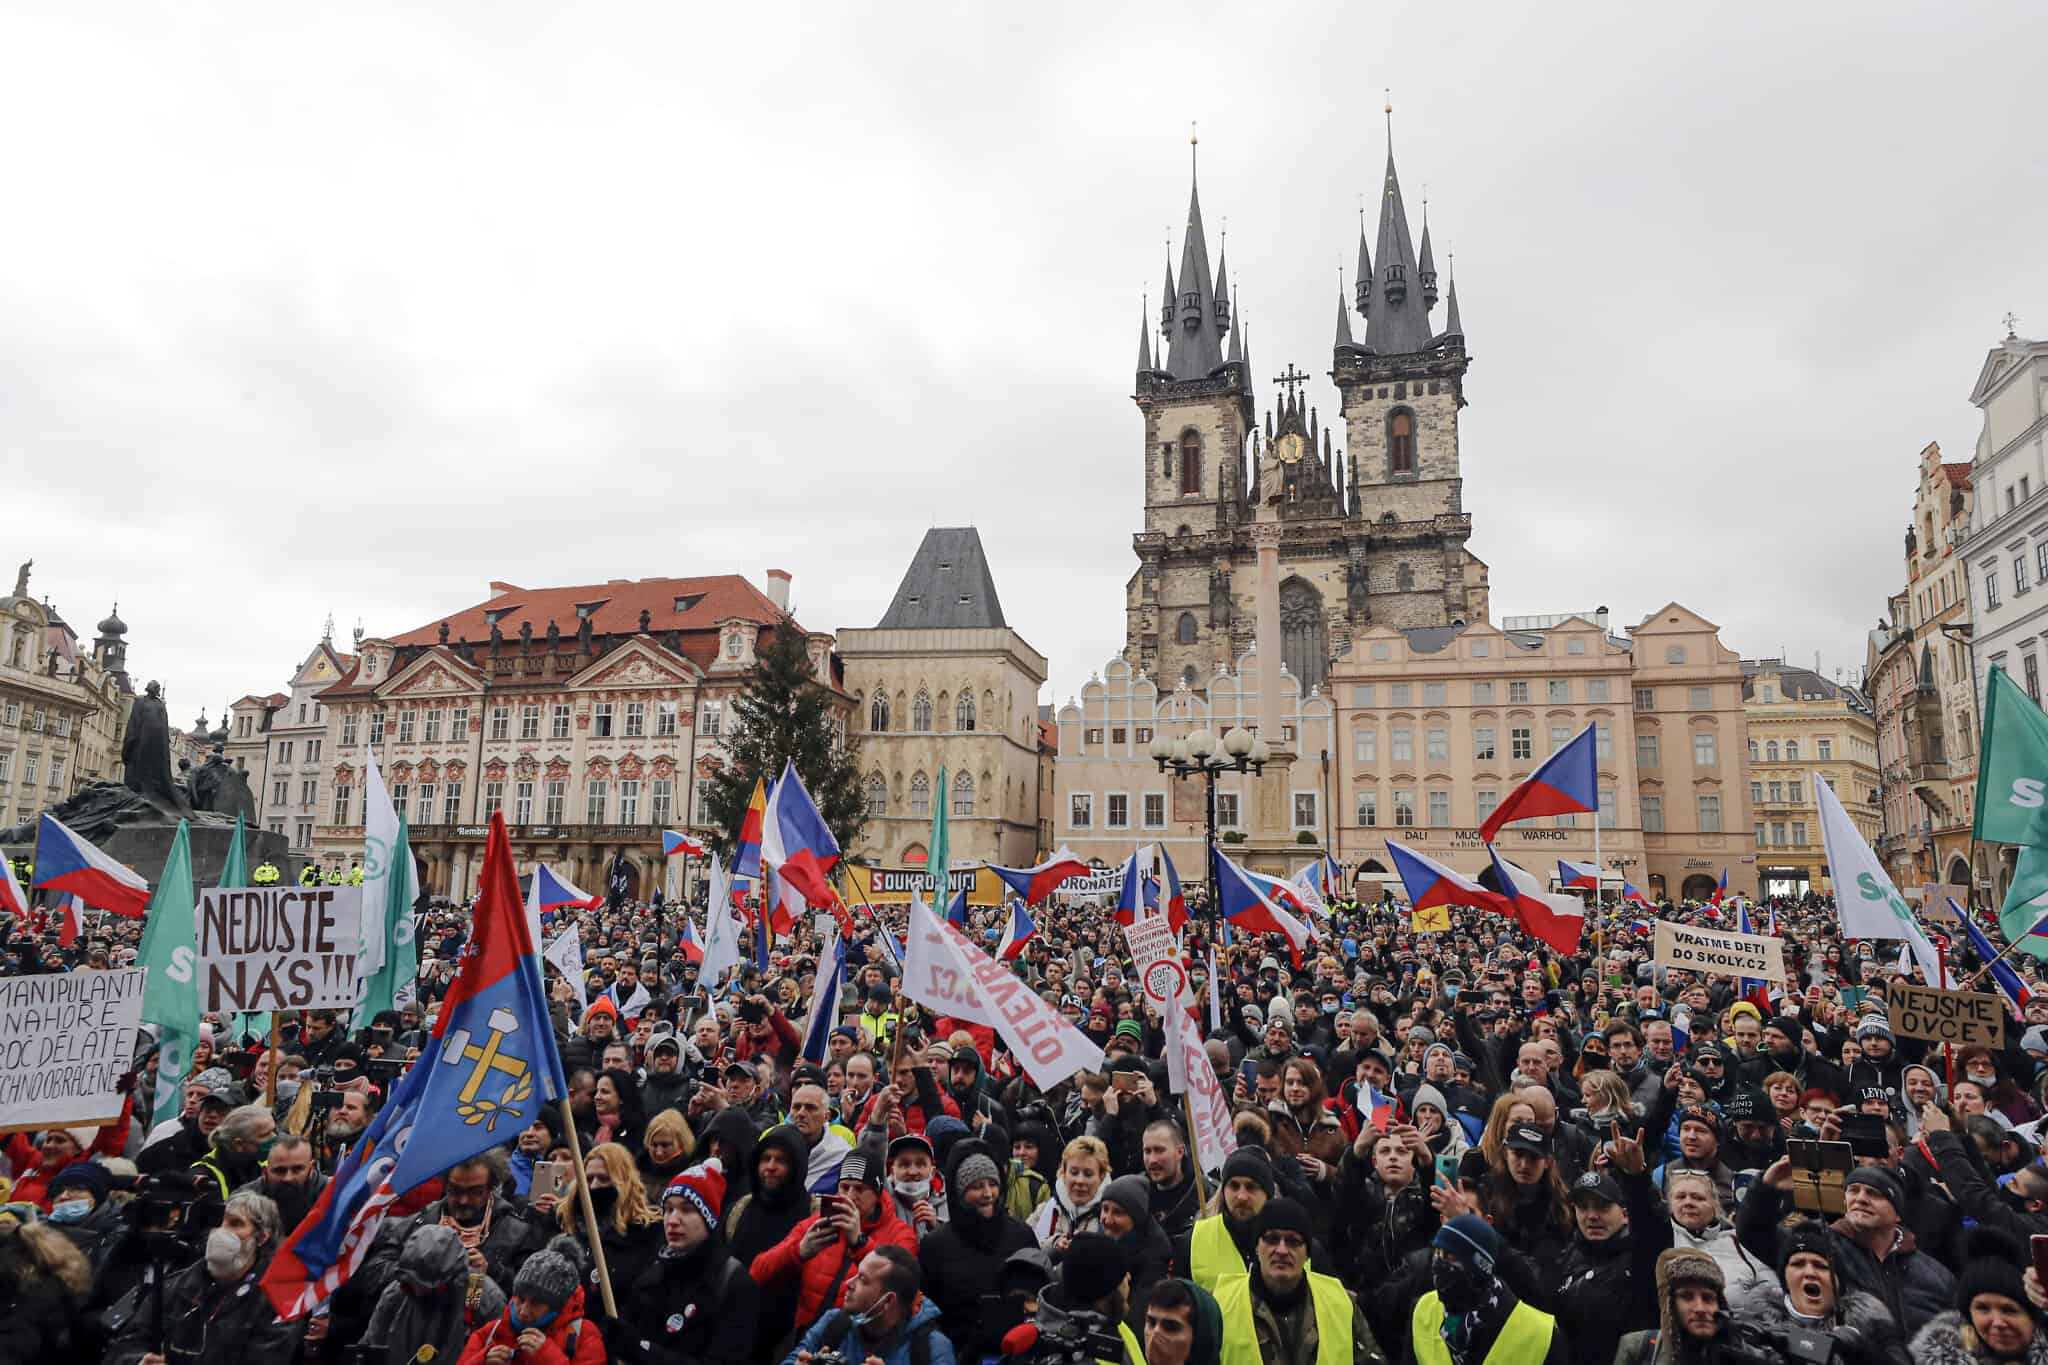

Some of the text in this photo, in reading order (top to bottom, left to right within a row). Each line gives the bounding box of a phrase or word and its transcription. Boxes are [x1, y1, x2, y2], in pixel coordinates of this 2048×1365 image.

[1405, 831, 1427, 840] DALI
[1522, 831, 1568, 841] WARHOL
[872, 871, 975, 891] SOUKRONÍCI
[1674, 932, 1766, 955] VRATME DETI
[1672, 949, 1767, 971] DO SKOLY.CZ
[1889, 989, 1994, 1021] NEJSME
